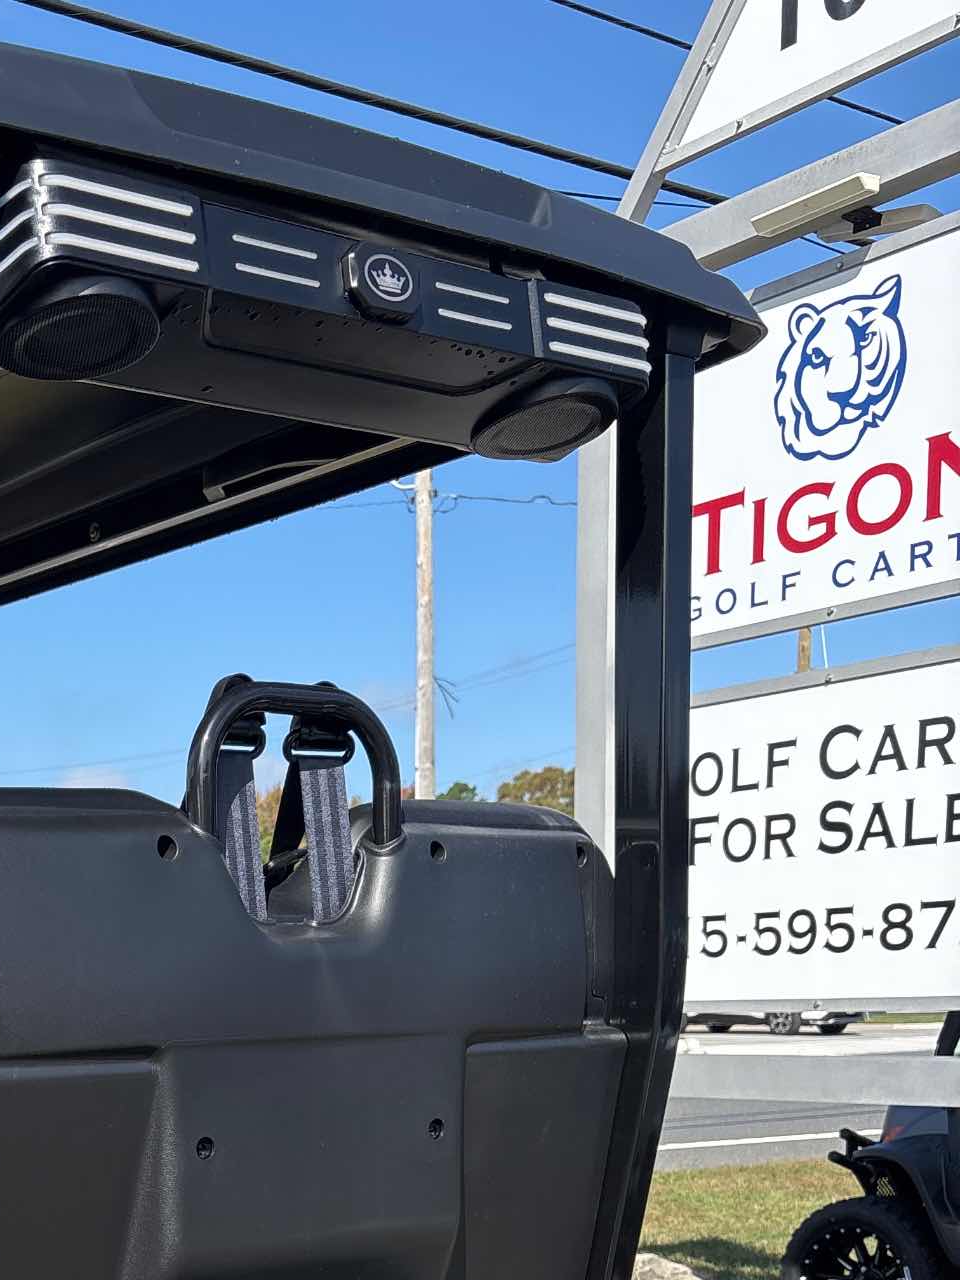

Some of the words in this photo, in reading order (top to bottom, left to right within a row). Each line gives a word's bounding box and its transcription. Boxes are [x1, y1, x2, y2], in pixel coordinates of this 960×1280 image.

[692, 431, 960, 576] TIGON
[690, 737, 797, 797] OLF
[689, 812, 796, 867] FOR
[689, 896, 960, 959] 5-595-87
